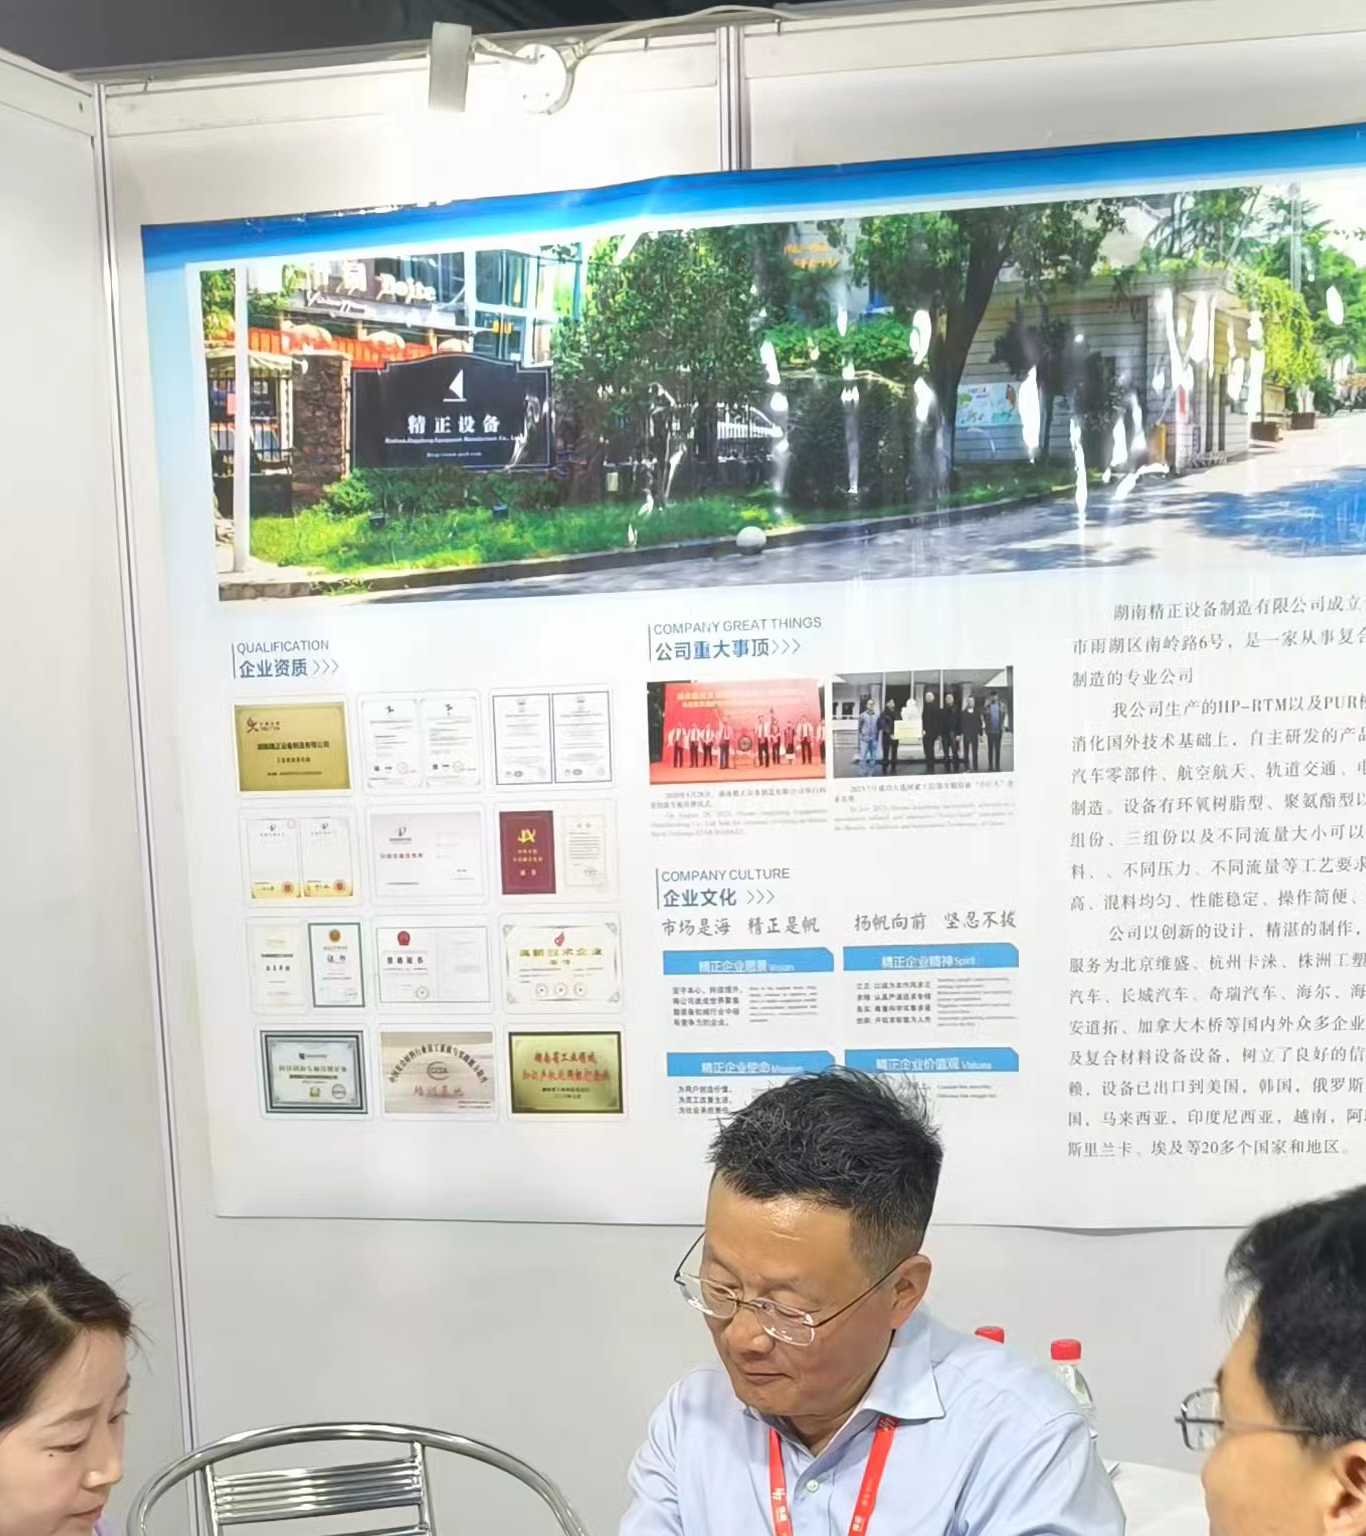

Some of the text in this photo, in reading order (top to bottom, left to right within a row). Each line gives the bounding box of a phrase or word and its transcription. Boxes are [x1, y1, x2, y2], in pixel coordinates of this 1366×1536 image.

[407, 414, 500, 434] 精正设备
[654, 617, 822, 635] COMPANY GREAT THINGS
[237, 640, 329, 655] QUALIFICATION
[239, 658, 307, 678] 企业资质
[1072, 668, 1194, 688] 制造的专业公司
[662, 868, 790, 882] COMPANY CULTURE
[663, 889, 736, 908] 企业文化
[662, 917, 731, 937] 市场是海
[855, 912, 926, 932] 扬帆向前
[944, 910, 1017, 930] 坚忍不拔
